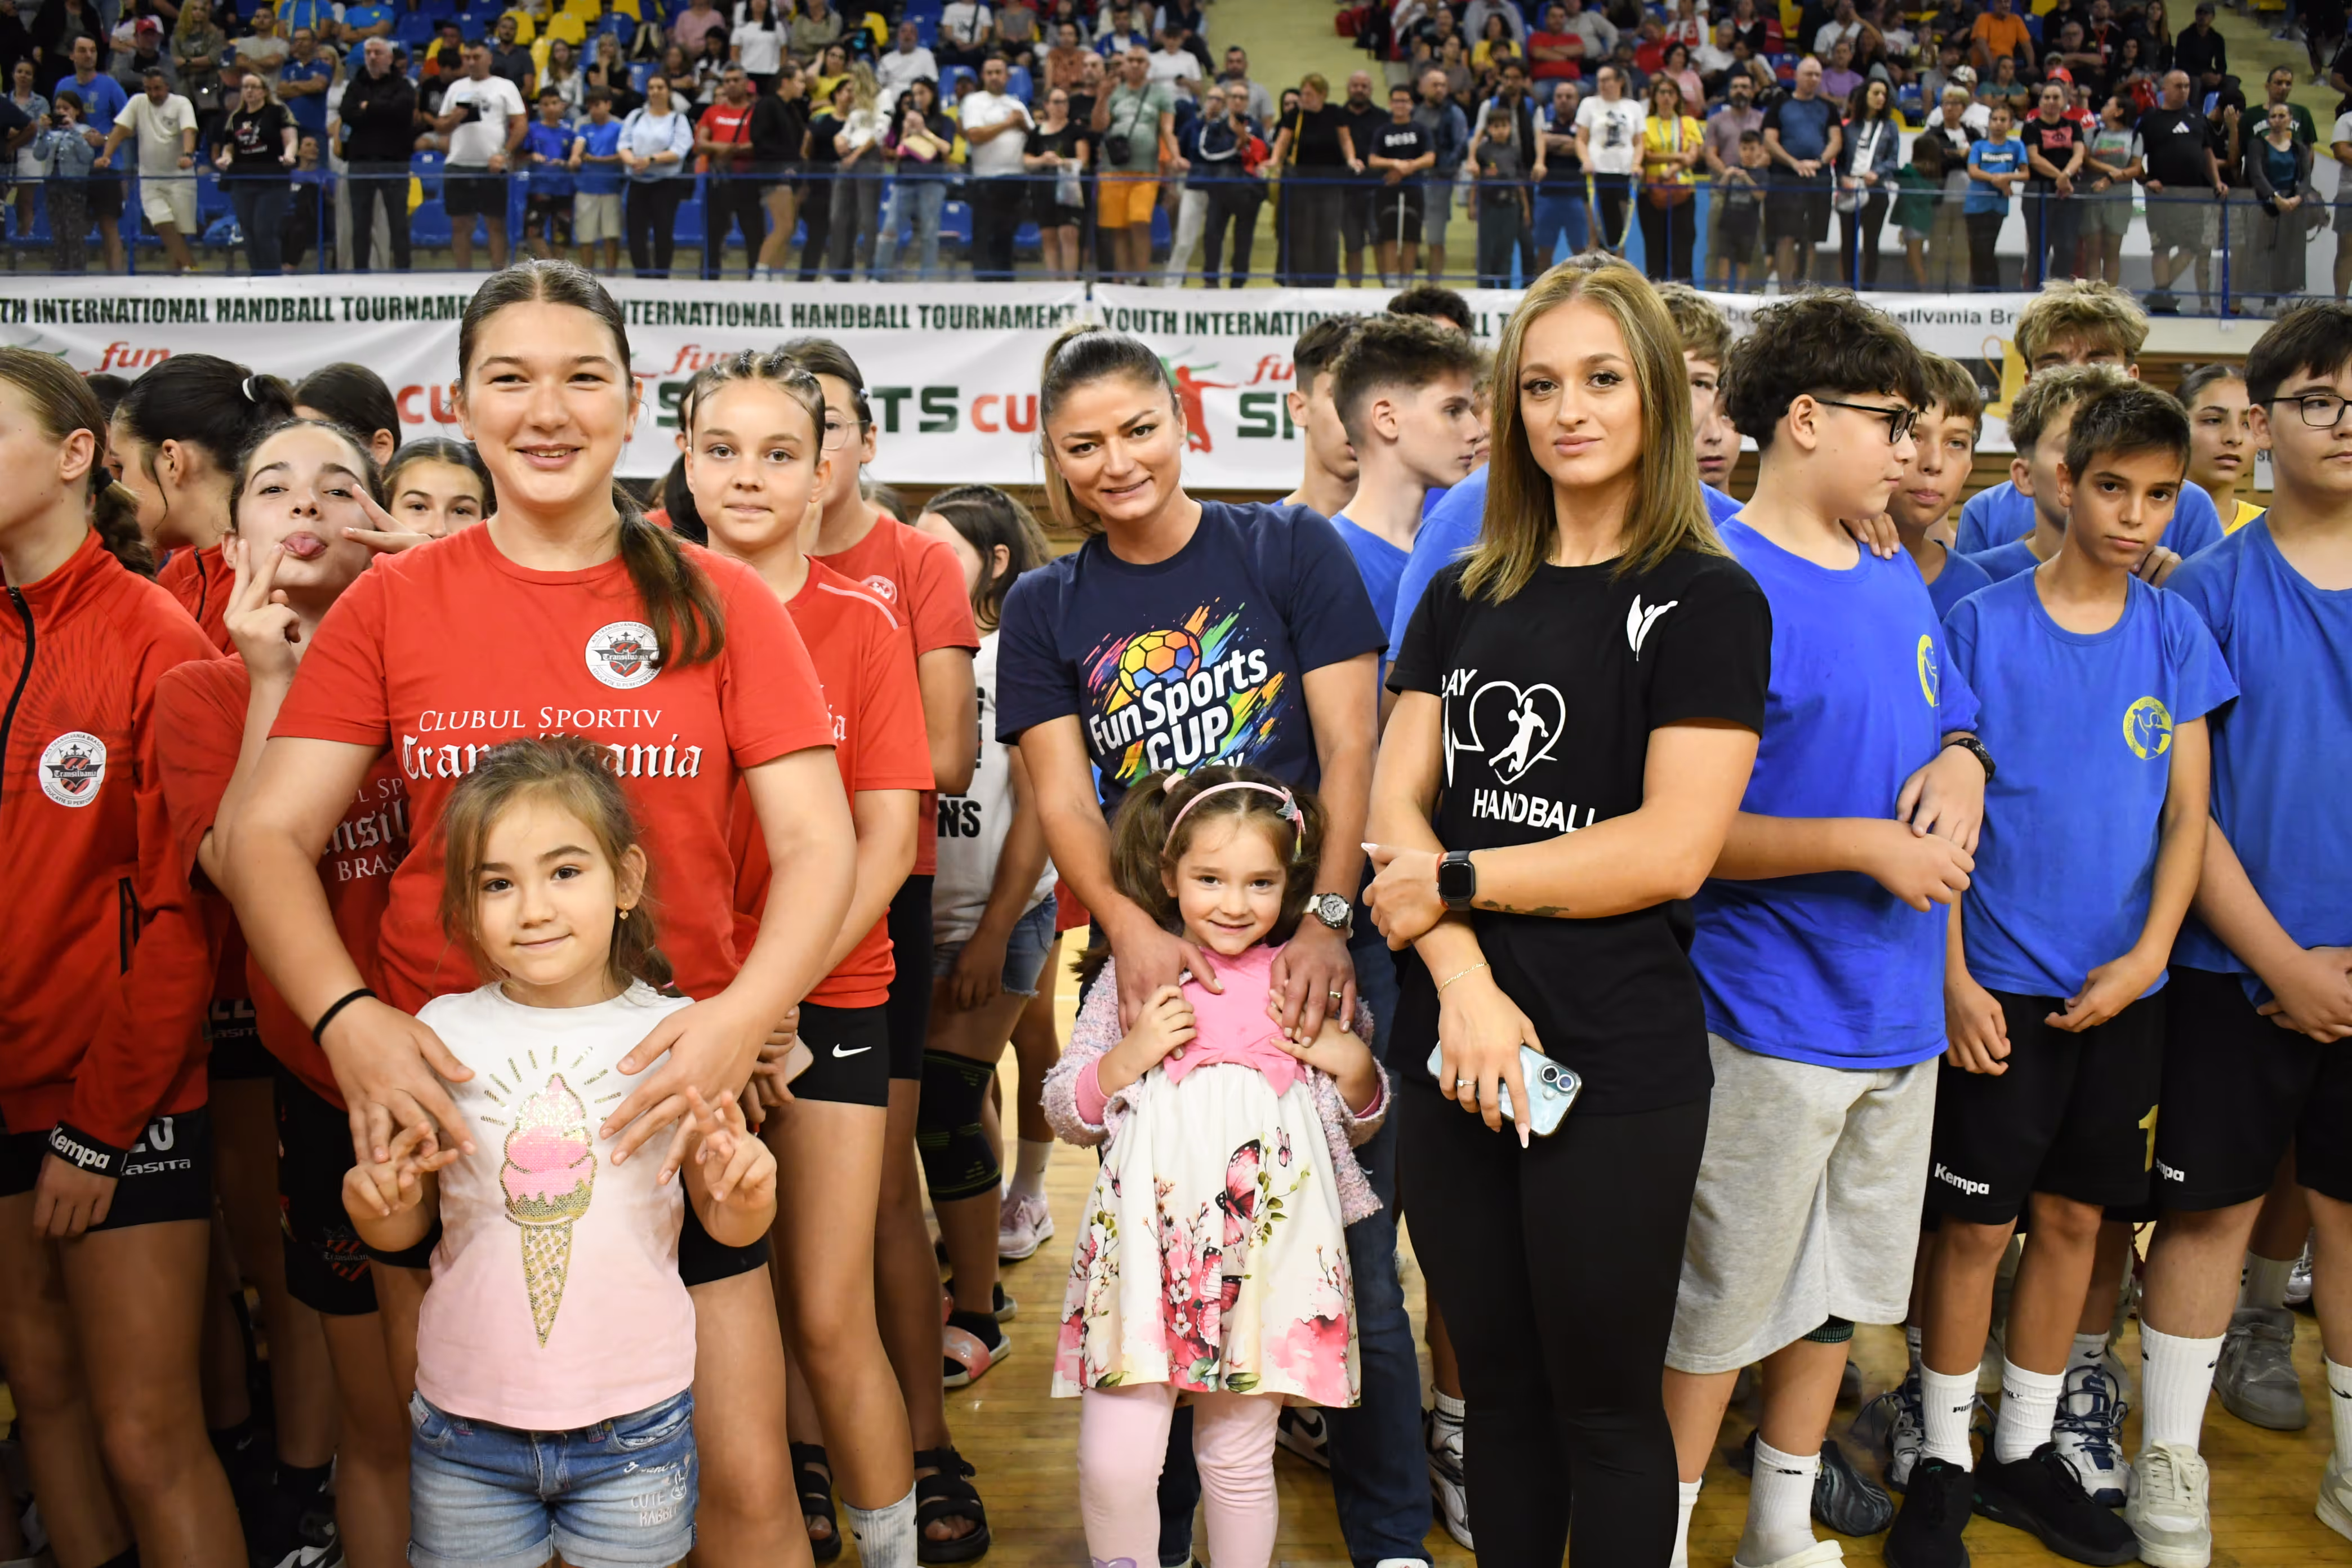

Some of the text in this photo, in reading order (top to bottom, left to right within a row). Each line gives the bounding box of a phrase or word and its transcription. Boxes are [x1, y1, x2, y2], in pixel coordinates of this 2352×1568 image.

[34, 297, 210, 324] INTERNATIONAL
[216, 296, 335, 323] HANDBALL
[341, 295, 471, 322] TOURNAME
[616, 300, 1076, 329] NTERNATIONAL HANDBALL TOURNAMENT
[1102, 307, 1178, 334] YOUTH
[397, 384, 458, 425] CU
[970, 393, 1038, 433] CU
[419, 706, 662, 732] CLUBUL SPORTIV
[1146, 706, 1229, 773] CUP
[48, 1124, 111, 1169] Kempa
[1934, 1162, 1990, 1195] Kempa
[631, 1490, 666, 1508] CUTE
